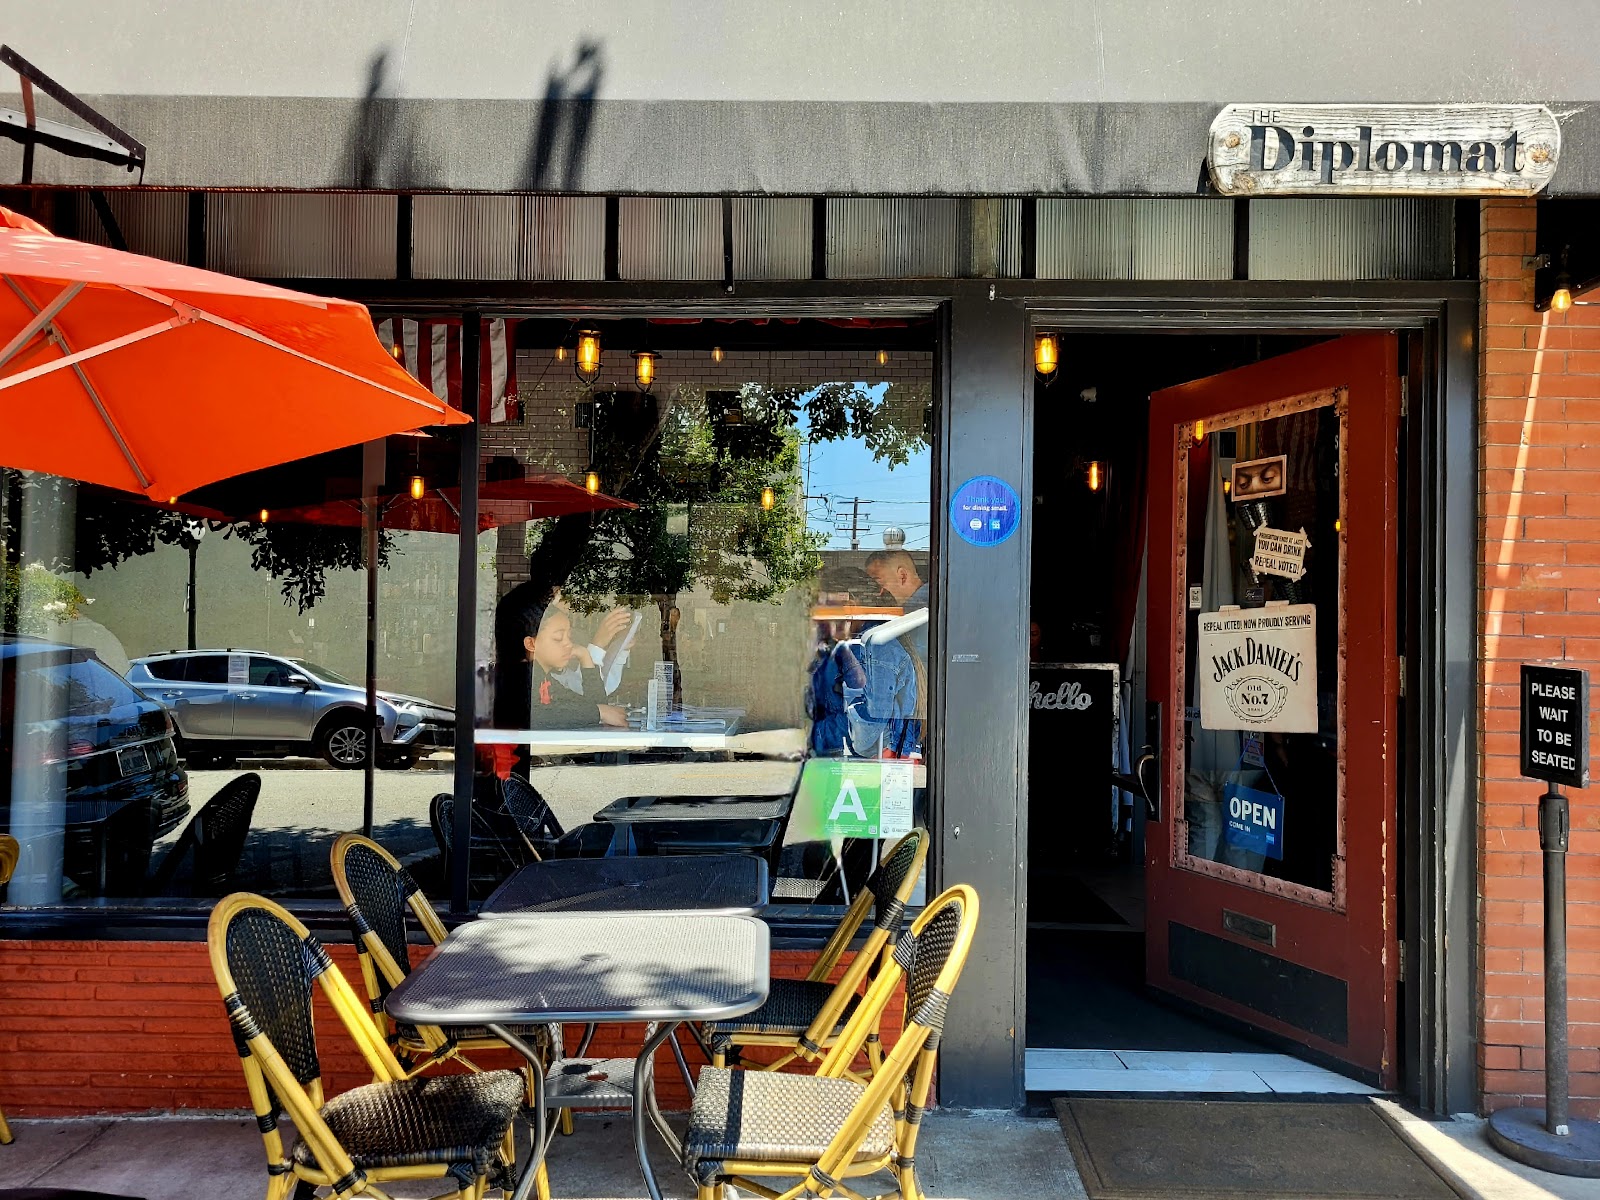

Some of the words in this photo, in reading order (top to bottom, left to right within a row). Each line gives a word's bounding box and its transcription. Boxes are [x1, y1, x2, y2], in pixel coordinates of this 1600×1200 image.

[1250, 110, 1281, 124] THE
[1245, 125, 1525, 185] Diplomat
[1258, 539, 1269, 550] YOU
[1270, 542, 1282, 553] CAN
[1283, 545, 1302, 557] DRINK
[1255, 556, 1277, 569] REPEAL
[1278, 560, 1300, 574] VOTED!
[1204, 620, 1222, 631] REPEAL
[1224, 619, 1242, 630] VOTED!
[1244, 619, 1257, 629] NOW
[1258, 617, 1283, 629] PROUDLY
[1285, 615, 1311, 626] SERVING
[1212, 646, 1245, 683] JACK
[1246, 637, 1303, 682] DANIEL'S
[1029, 681, 1093, 710] hello
[1532, 683, 1575, 700] PLEASE
[1539, 706, 1568, 722] WAIT
[1537, 729, 1552, 743] TO
[1555, 732, 1572, 746] BE
[1532, 750, 1575, 770] SEATED
[828, 779, 868, 821] A
[1229, 797, 1276, 829] OPEN
[1229, 820, 1243, 831] COME
